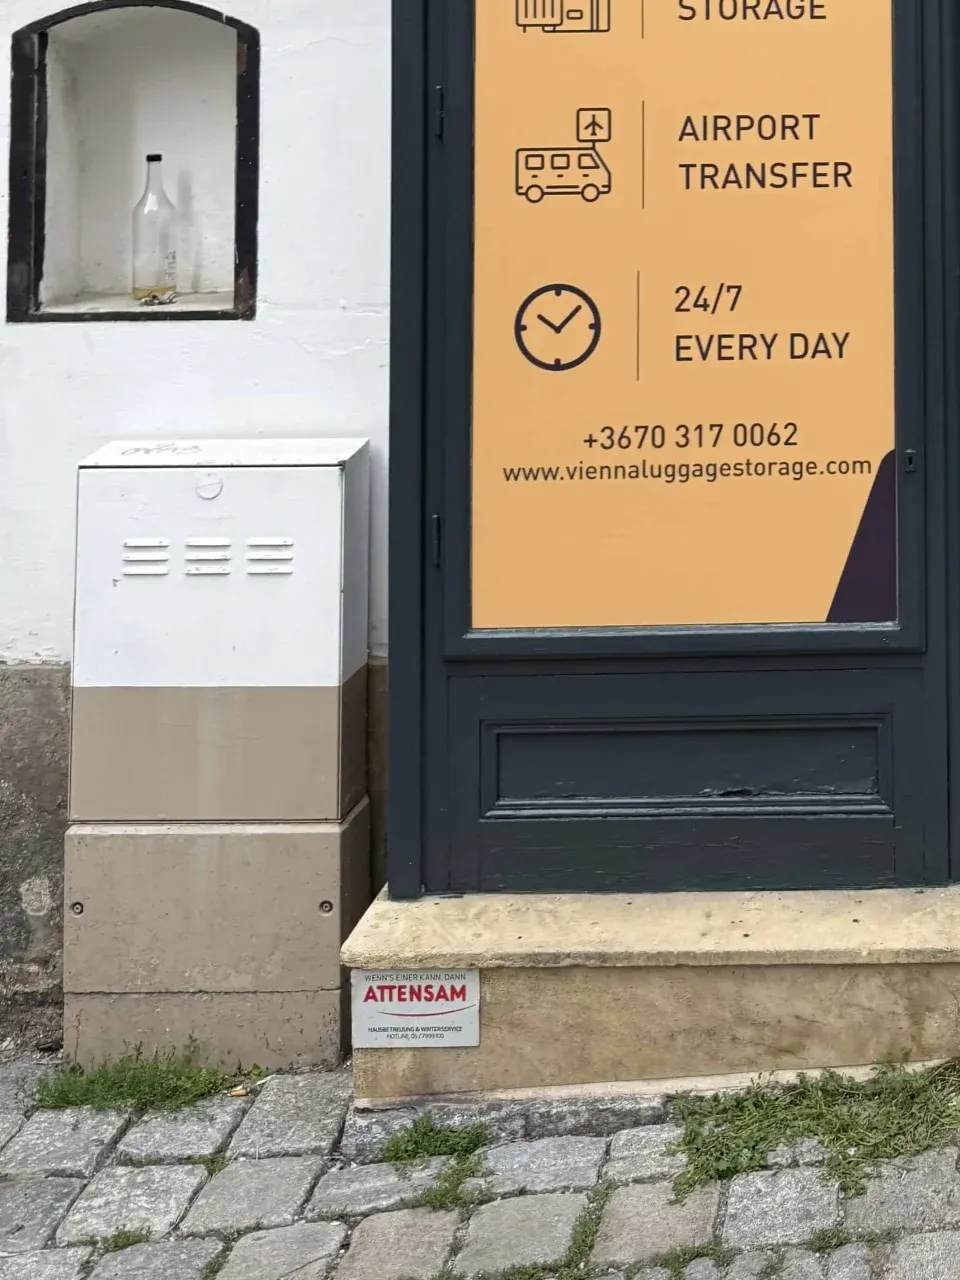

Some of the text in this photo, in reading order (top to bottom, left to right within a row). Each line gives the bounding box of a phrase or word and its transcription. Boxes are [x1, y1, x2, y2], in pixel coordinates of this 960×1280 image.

[677, 113, 821, 141] AIRPORT
[678, 161, 854, 190] TRANSFER
[673, 283, 743, 314] 24/7
[674, 331, 851, 361] EVERY DAY
[583, 422, 799, 450] +3670 317 0062
[502, 456, 872, 483] www.viennaluggagestorage.com
[364, 973, 394, 982] WENN'S
[395, 973, 418, 982] EINER
[444, 972, 466, 981] DANN
[363, 984, 467, 1003] ATTENSAM
